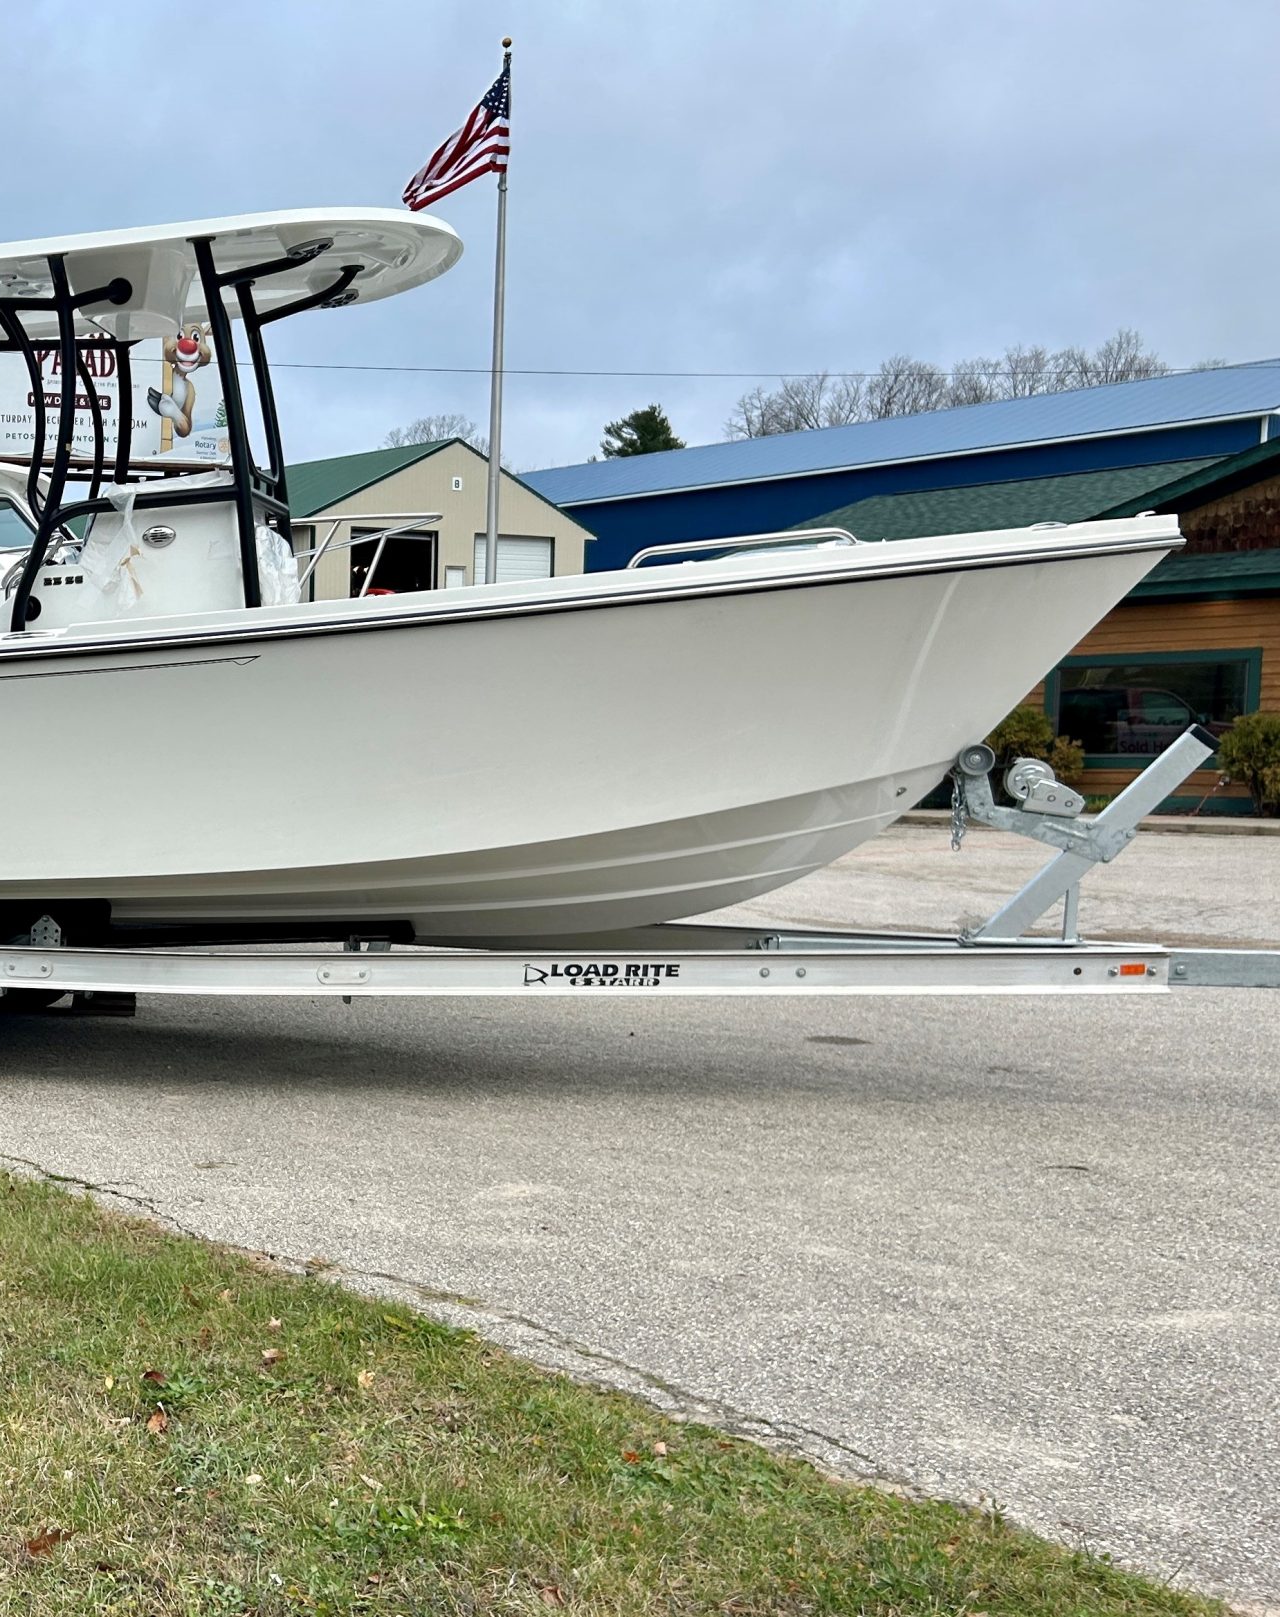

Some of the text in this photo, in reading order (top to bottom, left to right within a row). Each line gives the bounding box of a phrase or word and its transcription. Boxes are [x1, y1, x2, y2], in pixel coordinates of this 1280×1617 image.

[35, 349, 119, 379] PAAD
[79, 397, 87, 406] &
[194, 440, 218, 450] Rotary
[1120, 740, 1149, 753] Sold
[550, 963, 680, 978] LOAD RITE
